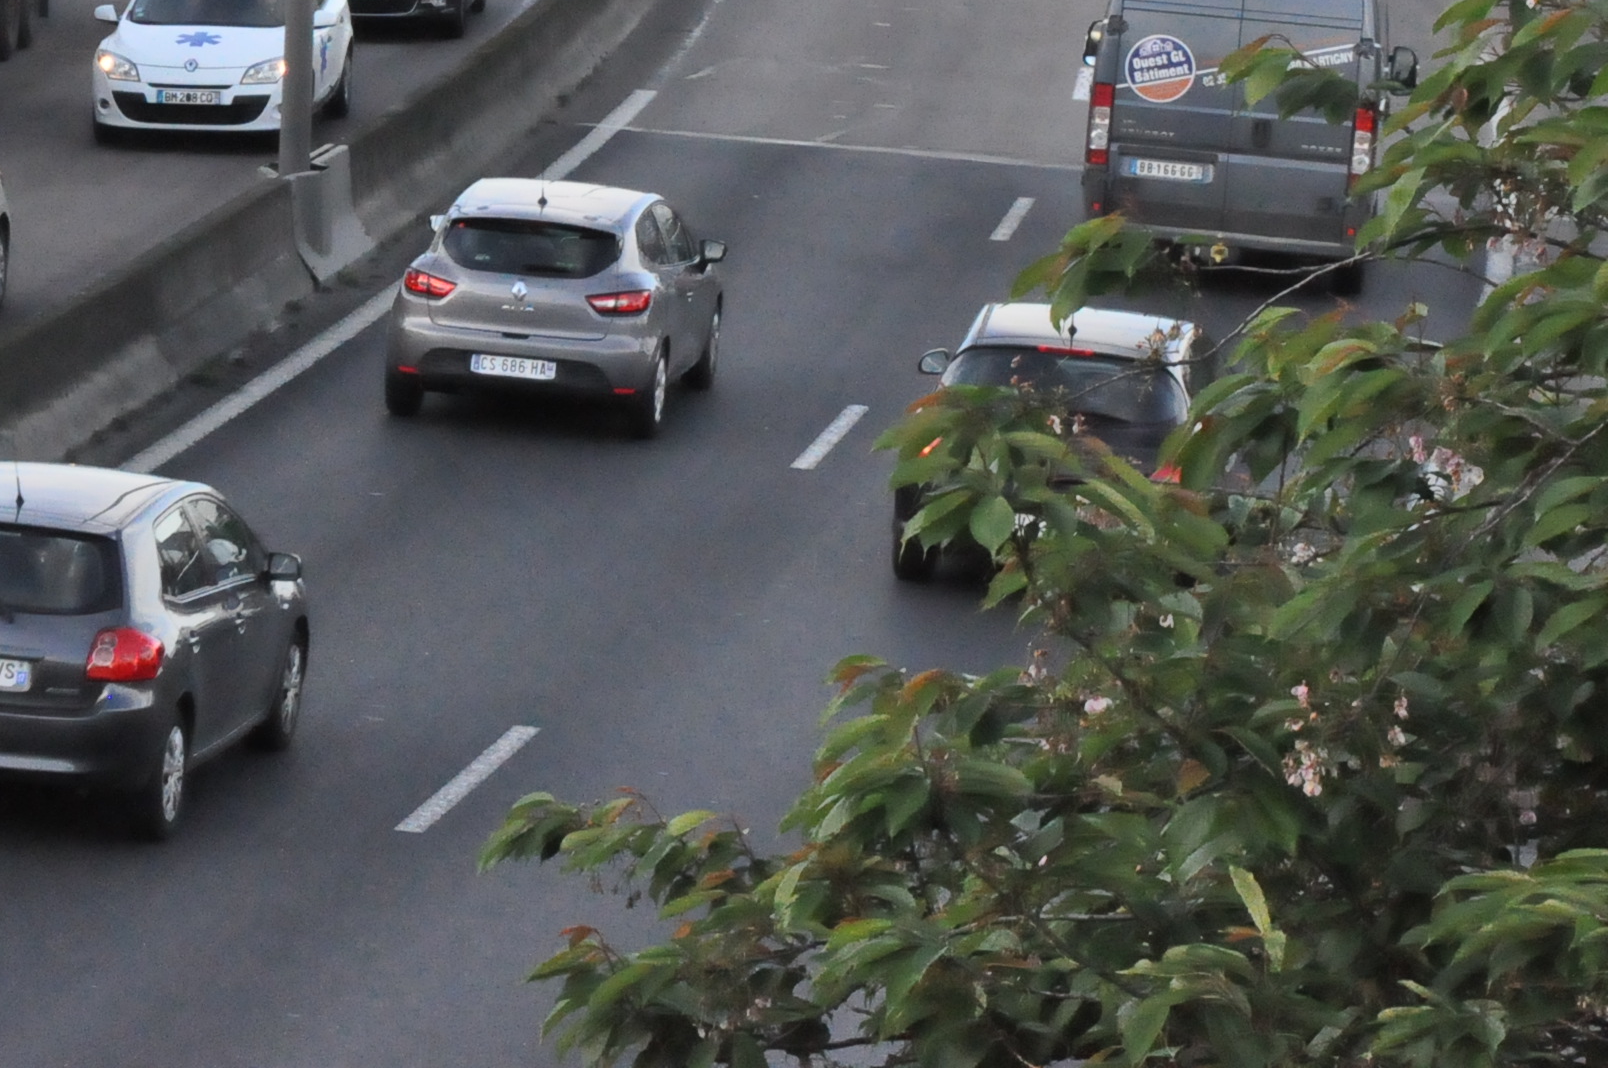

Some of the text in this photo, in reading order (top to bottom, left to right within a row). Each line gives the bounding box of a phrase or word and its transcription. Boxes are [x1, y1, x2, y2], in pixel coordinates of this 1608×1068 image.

[1132, 50, 1187, 70] Ouest GL
[1134, 64, 1190, 82] Bâtiment
